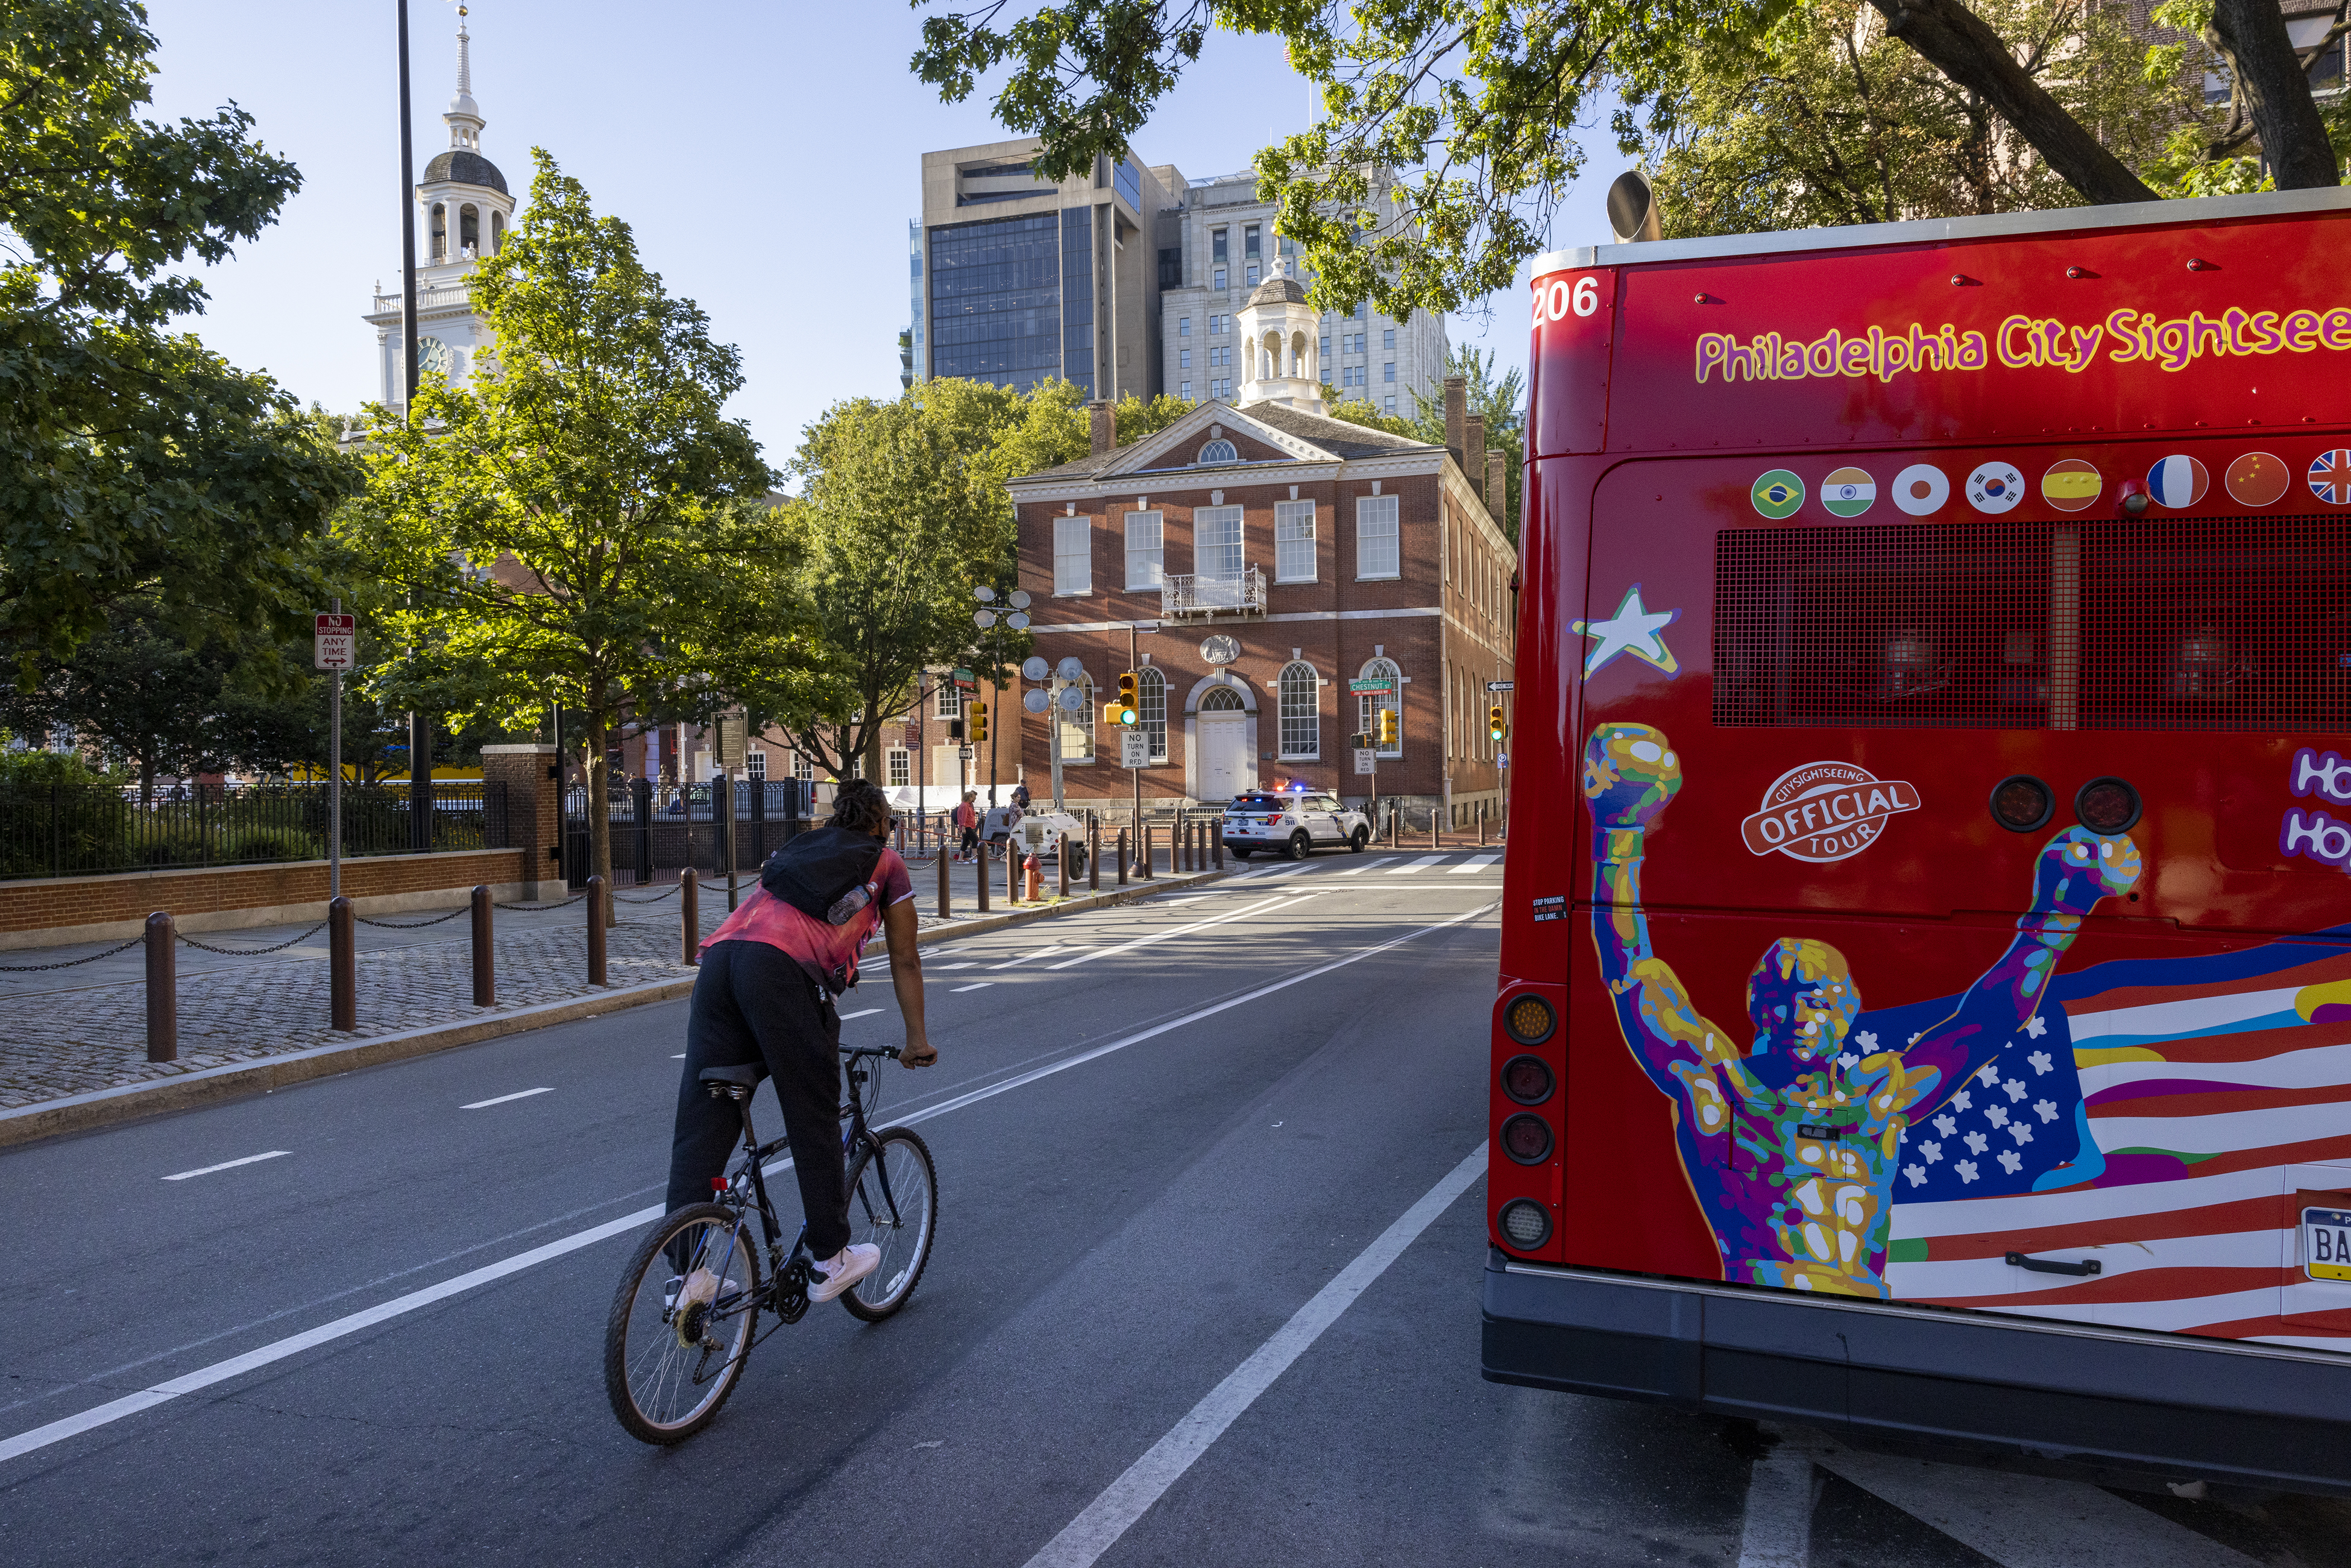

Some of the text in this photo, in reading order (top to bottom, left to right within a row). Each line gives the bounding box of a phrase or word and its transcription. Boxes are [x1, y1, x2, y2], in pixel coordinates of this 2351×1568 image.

[1532, 277, 1597, 331] 206
[1696, 307, 2351, 383] Philadelphia City Sightsee
[329, 616, 342, 626] NO
[1775, 768, 1864, 802] CITYSIGHTSEEING
[1760, 786, 1909, 843] OFFICIAL
[1810, 823, 1876, 854] TOUR
[2284, 811, 2351, 869] Ho
[1544, 896, 1564, 905] PARKING
[2315, 1228, 2351, 1263] BA
